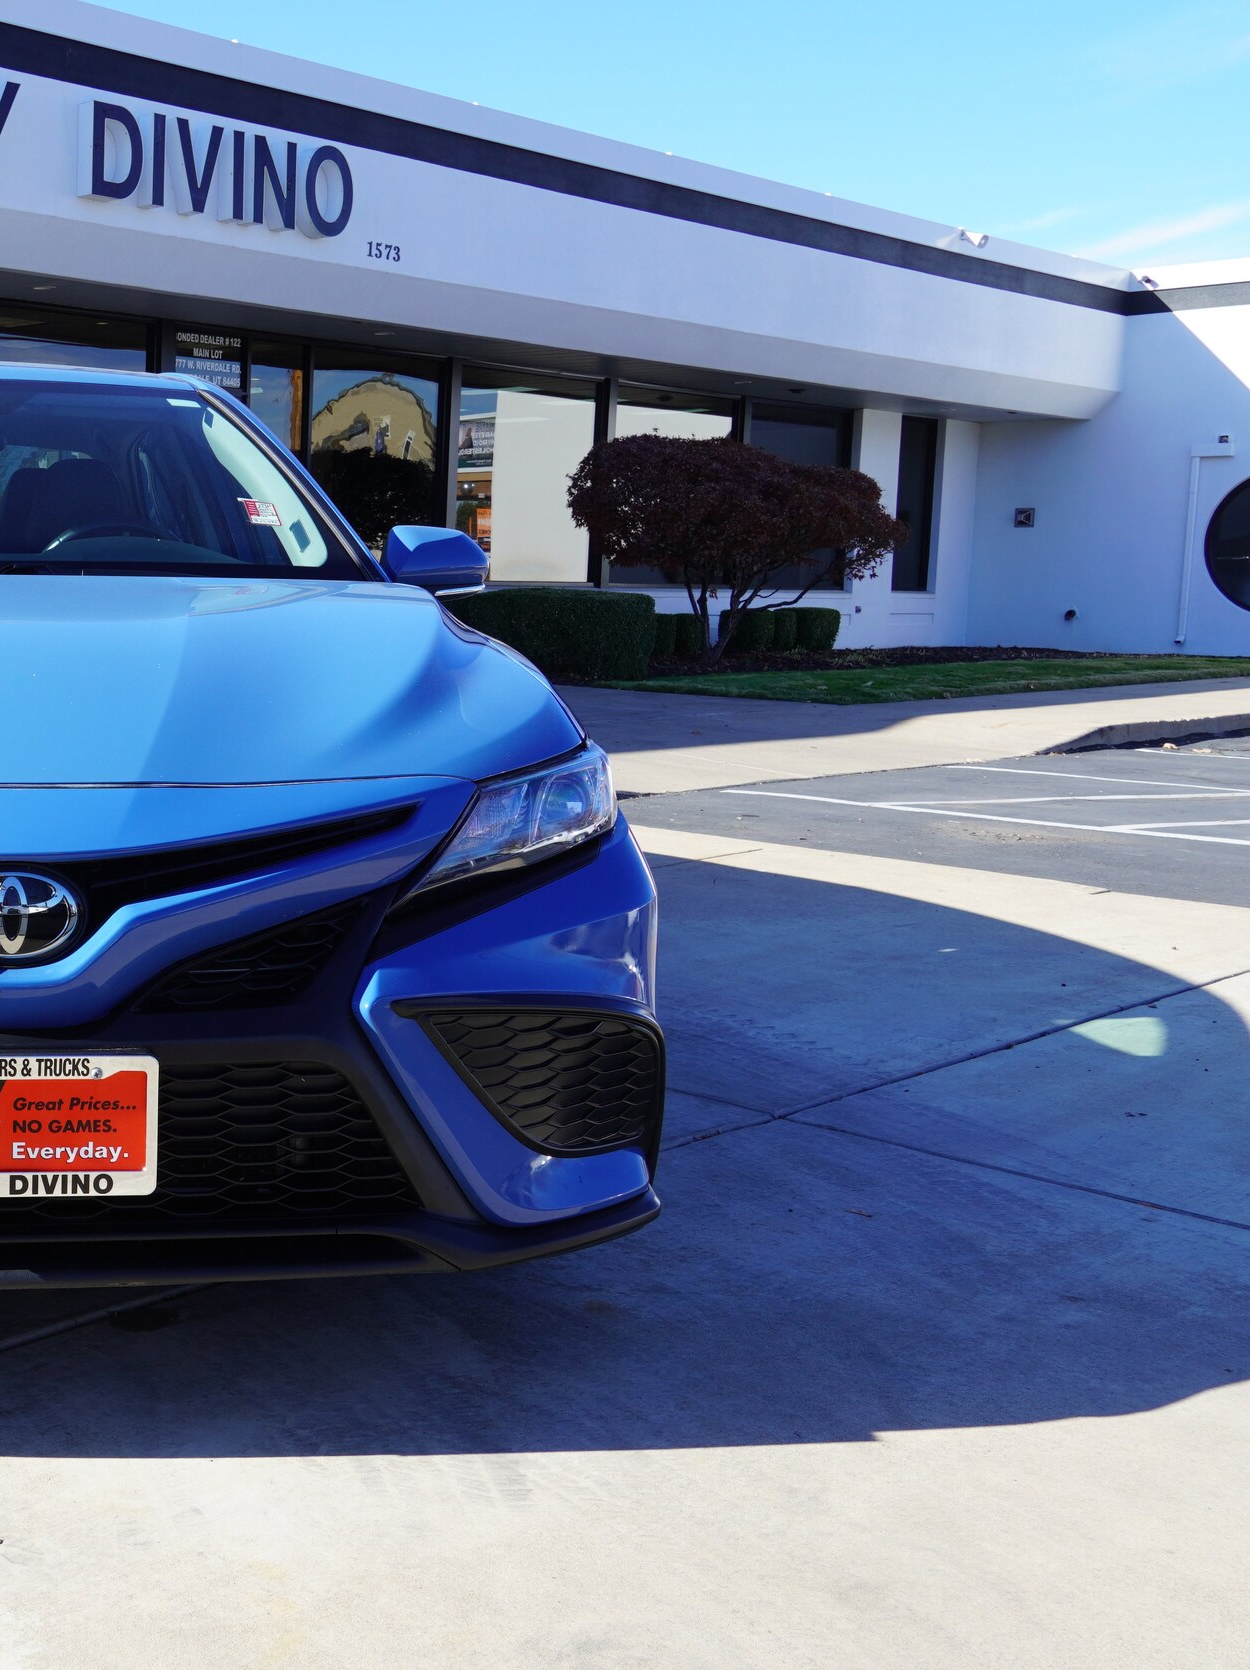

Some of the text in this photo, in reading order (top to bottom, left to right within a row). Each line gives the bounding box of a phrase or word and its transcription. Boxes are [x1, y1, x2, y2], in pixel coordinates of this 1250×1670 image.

[78, 100, 354, 240] DIVINO
[366, 241, 401, 262] 1573
[176, 332, 199, 343] ONDED
[200, 335, 224, 346] DEALER
[230, 338, 241, 347] 122
[193, 348, 223, 359] MAIN LOT
[187, 360, 195, 369] W.
[196, 361, 230, 372] RIVERDALE
[232, 364, 242, 374] RD.
[213, 376, 222, 385] UT
[223, 377, 241, 387] 84405
[21, 1059, 32, 1078] &
[36, 1058, 90, 1078] TRUCKS
[12, 1096, 137, 1112] Great Prices...
[12, 1119, 118, 1134] NO GAMES.
[12, 1141, 130, 1164] Everyday.
[8, 1173, 114, 1196] DIVINO
